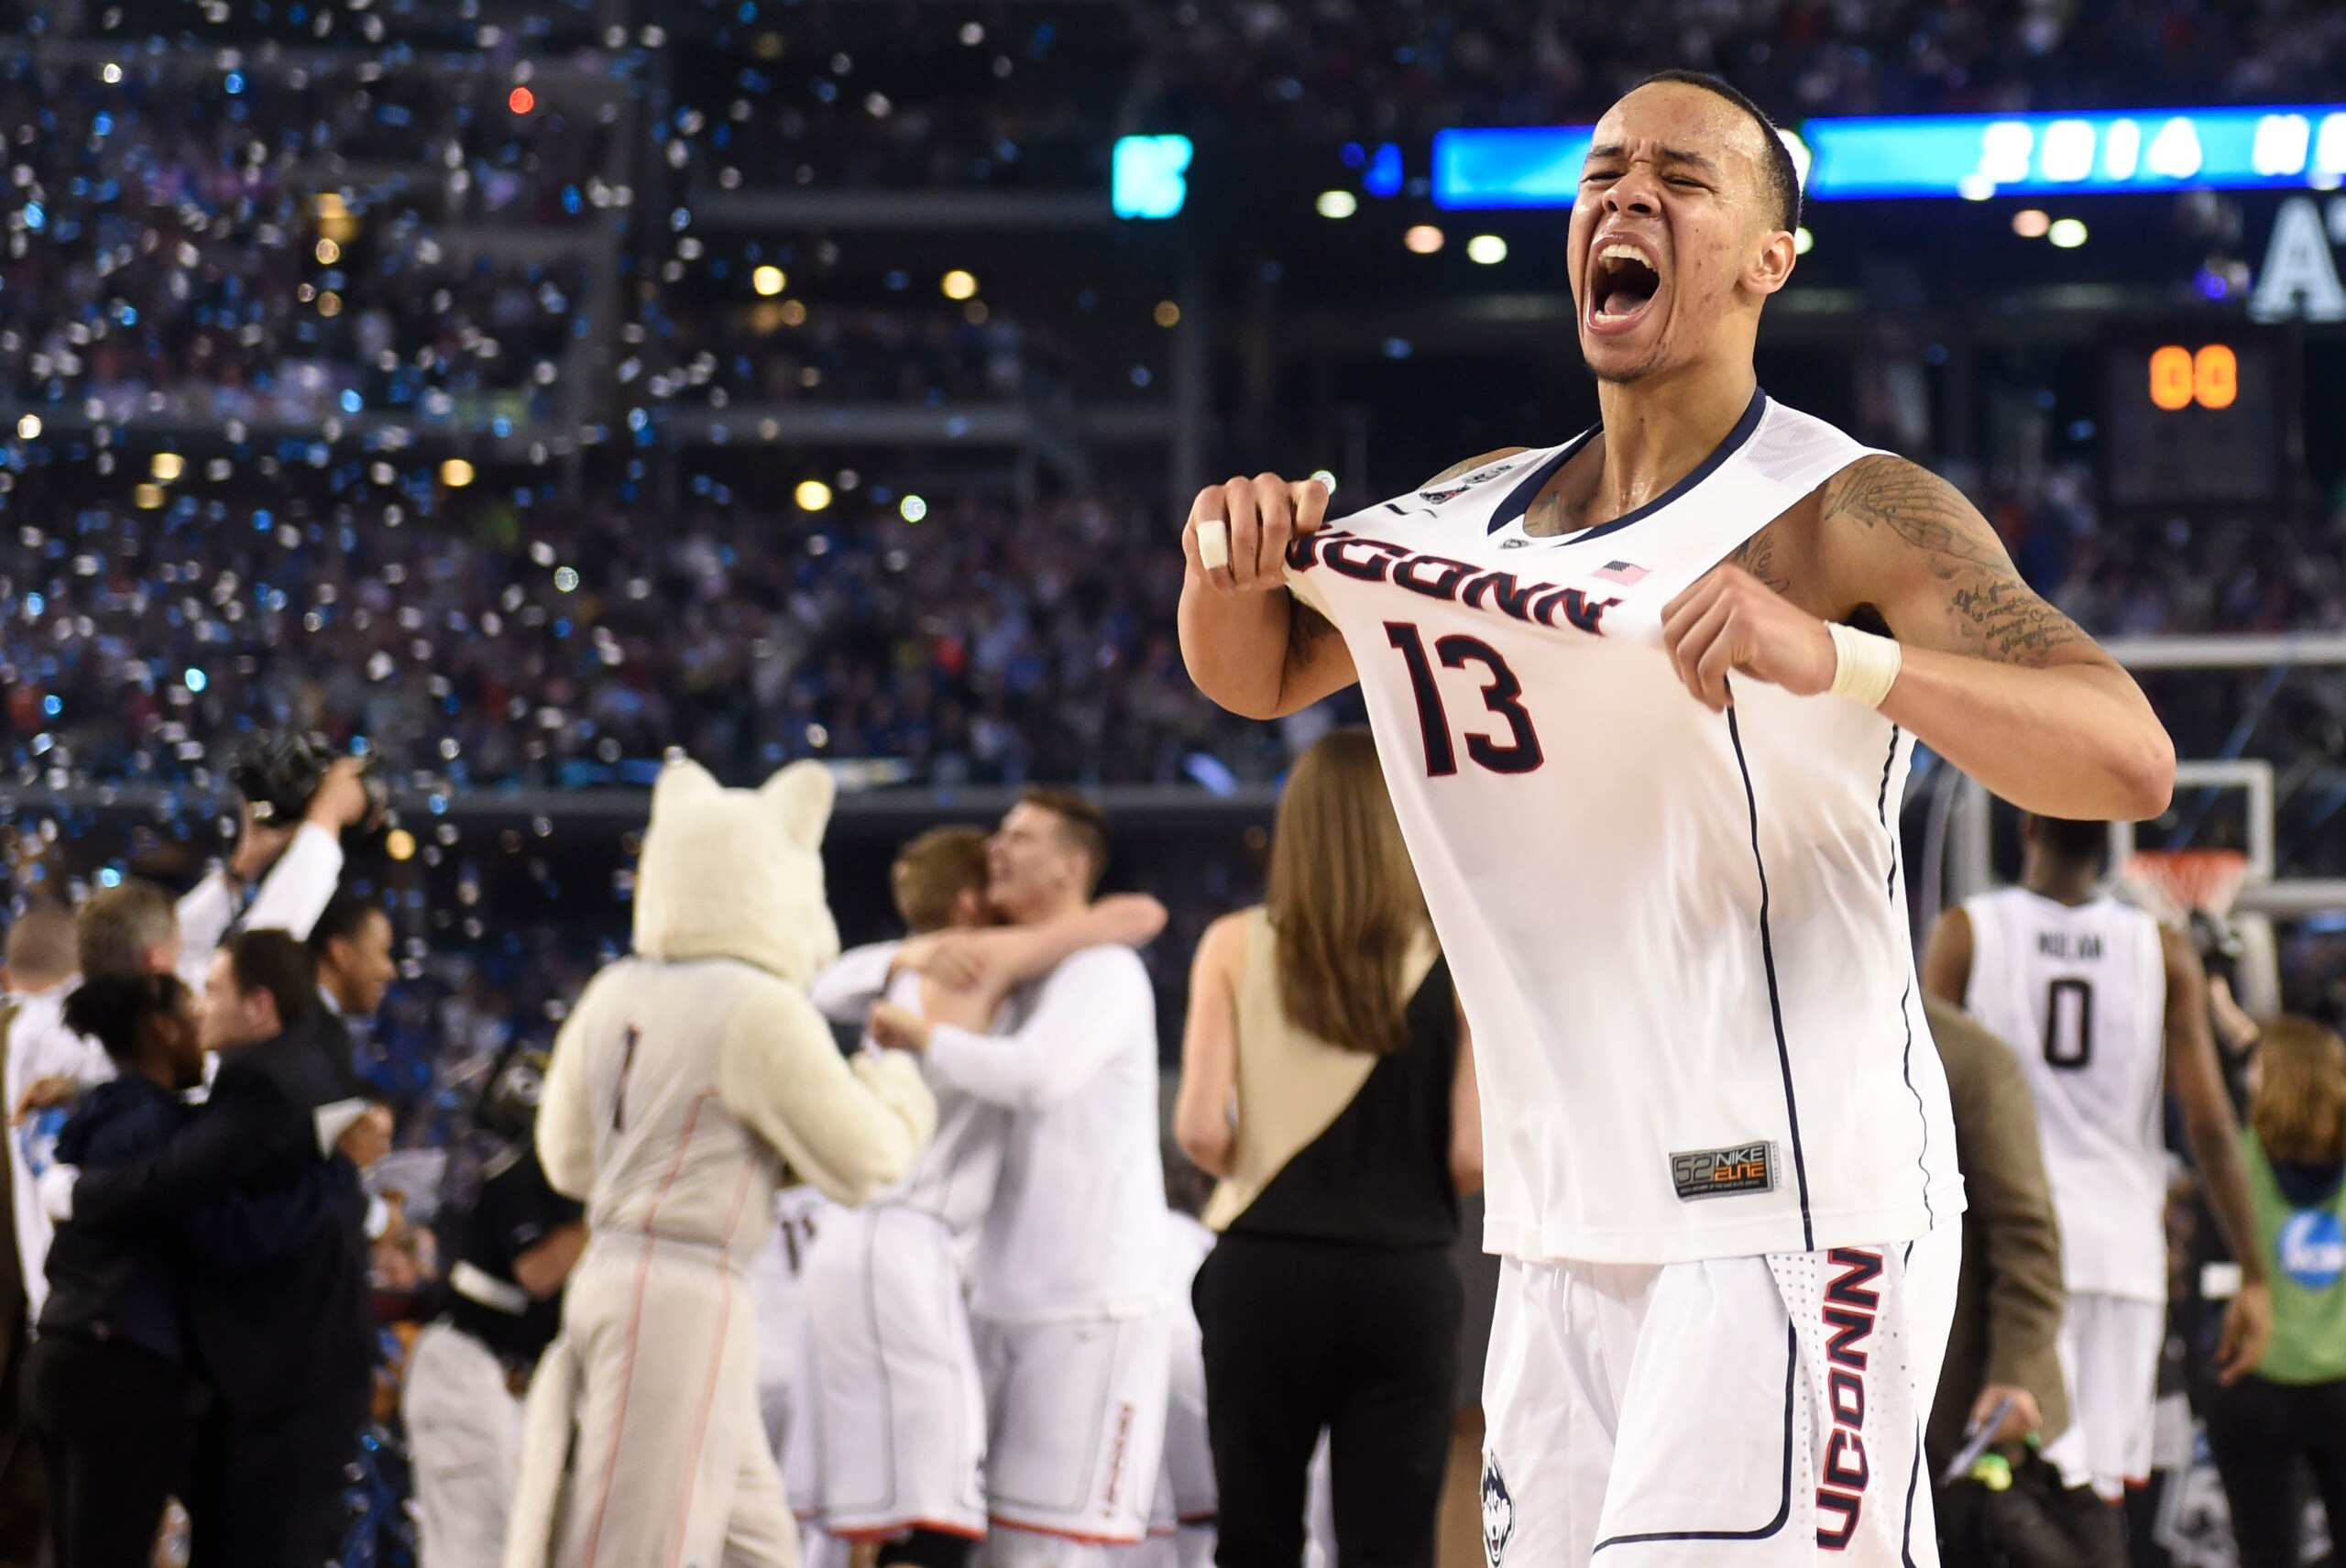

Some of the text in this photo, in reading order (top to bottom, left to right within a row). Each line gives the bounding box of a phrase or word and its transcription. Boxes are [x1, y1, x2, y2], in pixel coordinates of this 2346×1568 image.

[2149, 343, 2238, 411] 00
[1383, 620, 1545, 777] 13
[2044, 979, 2093, 1070] 0
[1676, 1157, 1713, 1184] 52
[1716, 1146, 1764, 1167] NIKE
[1814, 1247, 1883, 1552] UCONN
